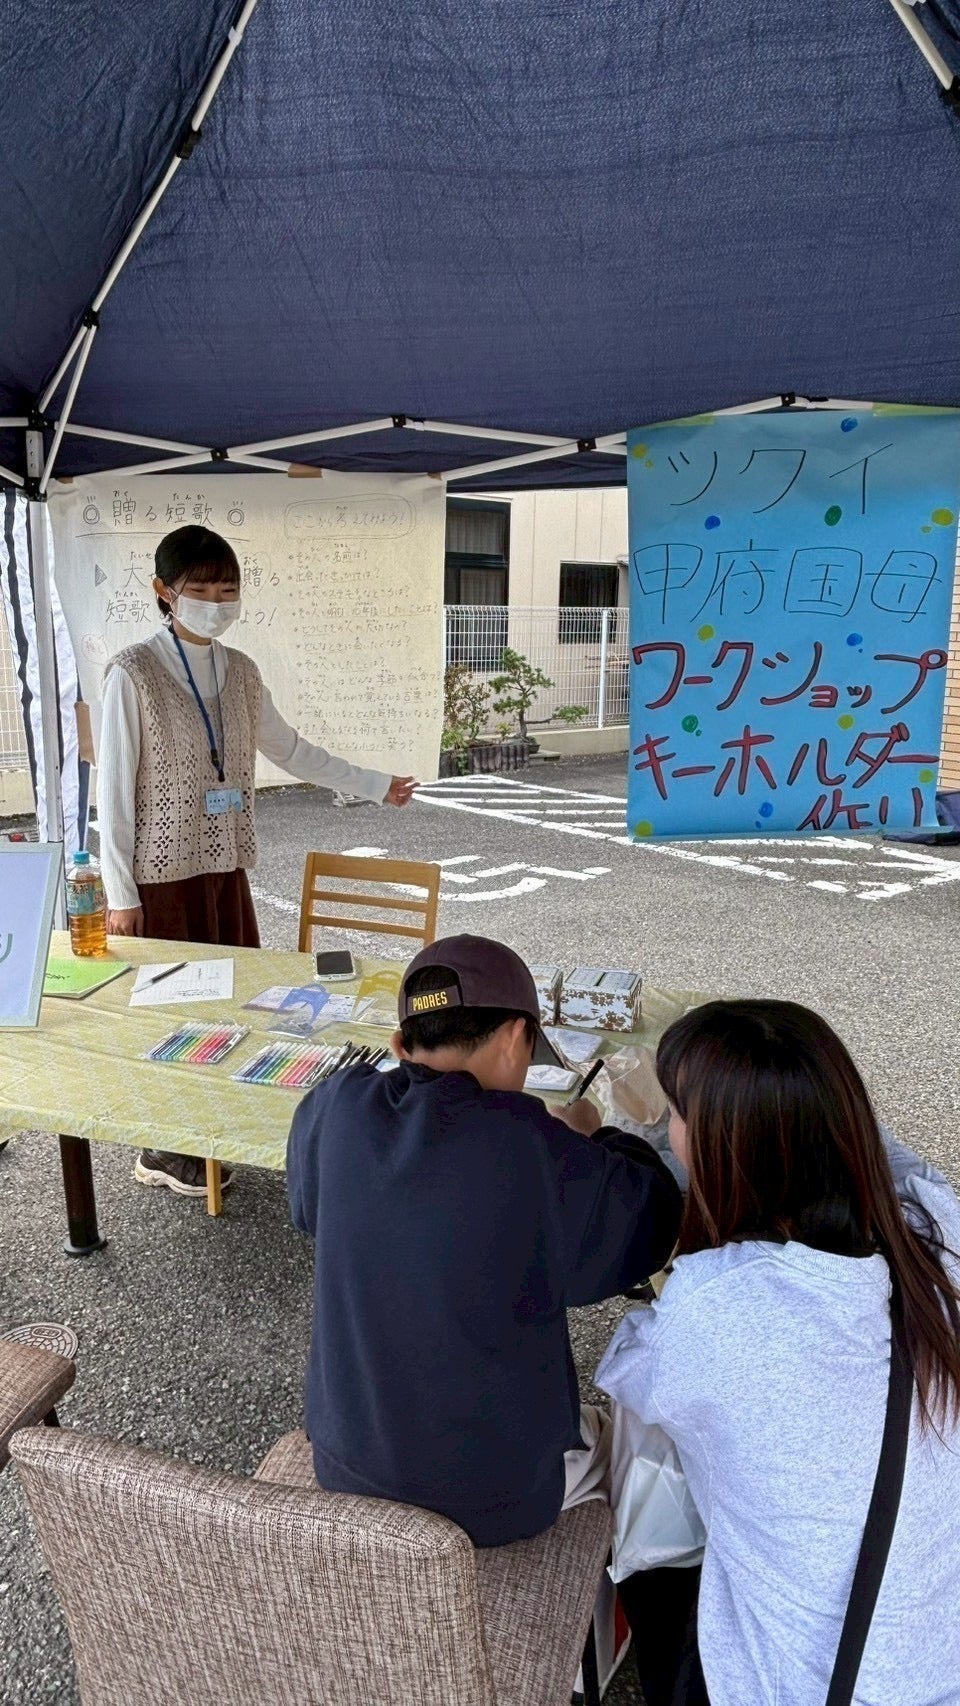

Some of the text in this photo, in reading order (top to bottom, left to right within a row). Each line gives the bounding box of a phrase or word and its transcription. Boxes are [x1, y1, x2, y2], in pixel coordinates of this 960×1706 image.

[667, 443, 894, 516] ツクイ
[172, 492, 206, 501] たんか
[112, 498, 214, 527] 贈る短歌
[242, 566, 281, 589] 贈る
[632, 539, 943, 625] 甲府国母
[105, 599, 152, 624] 短歌
[240, 607, 277, 627] よう!
[632, 641, 948, 715] ワークショップ
[632, 722, 941, 800] キーホルダー
[796, 787, 923, 832] 作り
[413, 991, 448, 1011] PADRES
